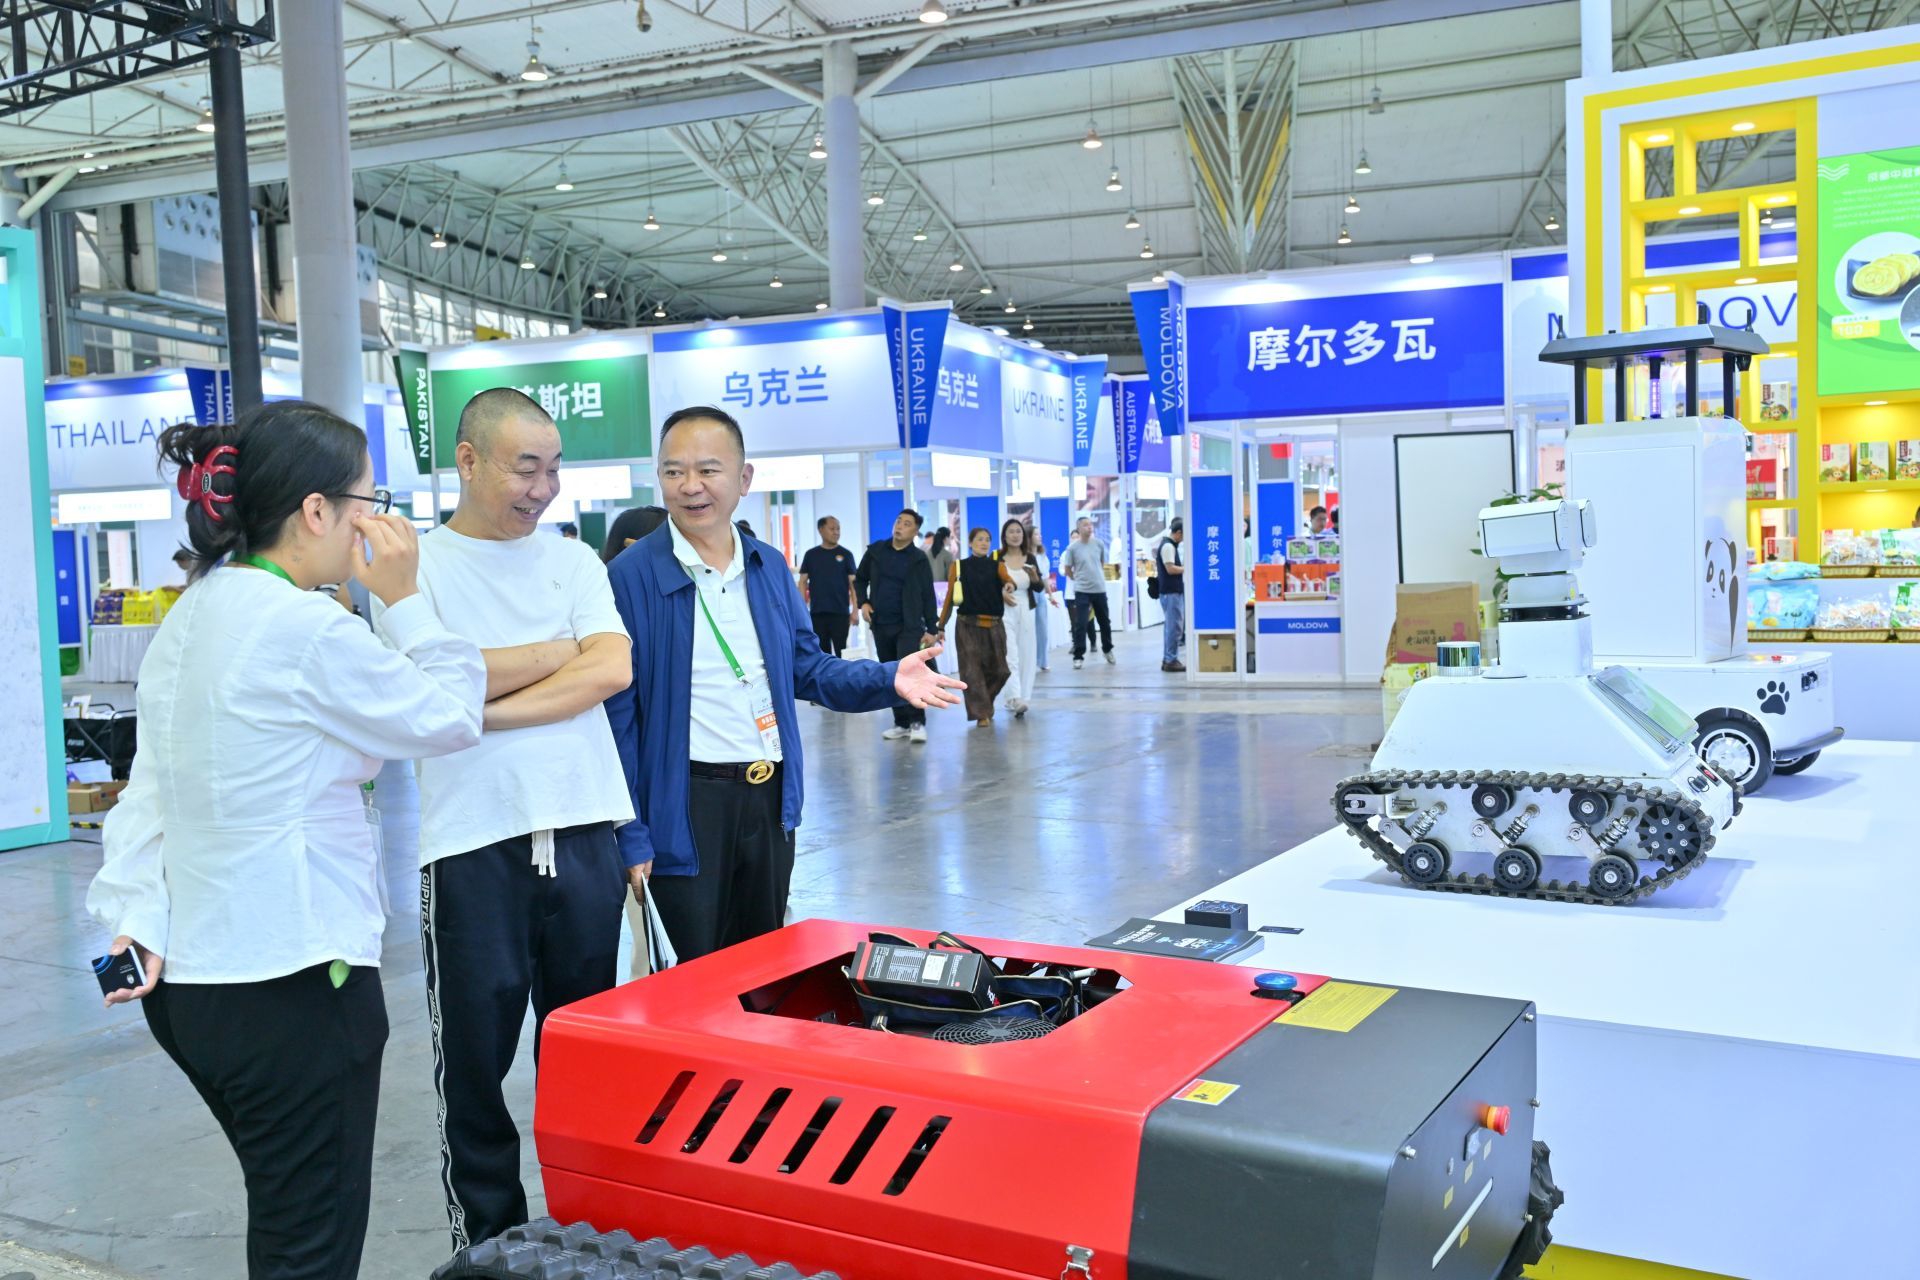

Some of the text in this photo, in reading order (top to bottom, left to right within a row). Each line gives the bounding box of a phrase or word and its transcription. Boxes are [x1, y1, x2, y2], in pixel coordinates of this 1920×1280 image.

[1160, 307, 1175, 412] MOLDOVA
[1176, 303, 1184, 409] MOLDOVA
[1247, 317, 1436, 372] 摩尔多瓦
[722, 364, 829, 408] 乌克兰
[910, 327, 927, 425] UKRAINE
[937, 366, 979, 409] 乌克兰
[1013, 388, 1064, 422] UKRAINE
[416, 367, 430, 458] PAKISTAN
[1074, 375, 1089, 450] UKRAINE
[1126, 390, 1137, 462] AUSTRALIA
[1207, 525, 1220, 581] 摩尔多瓦
[1287, 621, 1329, 630] MOLDOVA
[421, 872, 431, 934] GIPITEX
